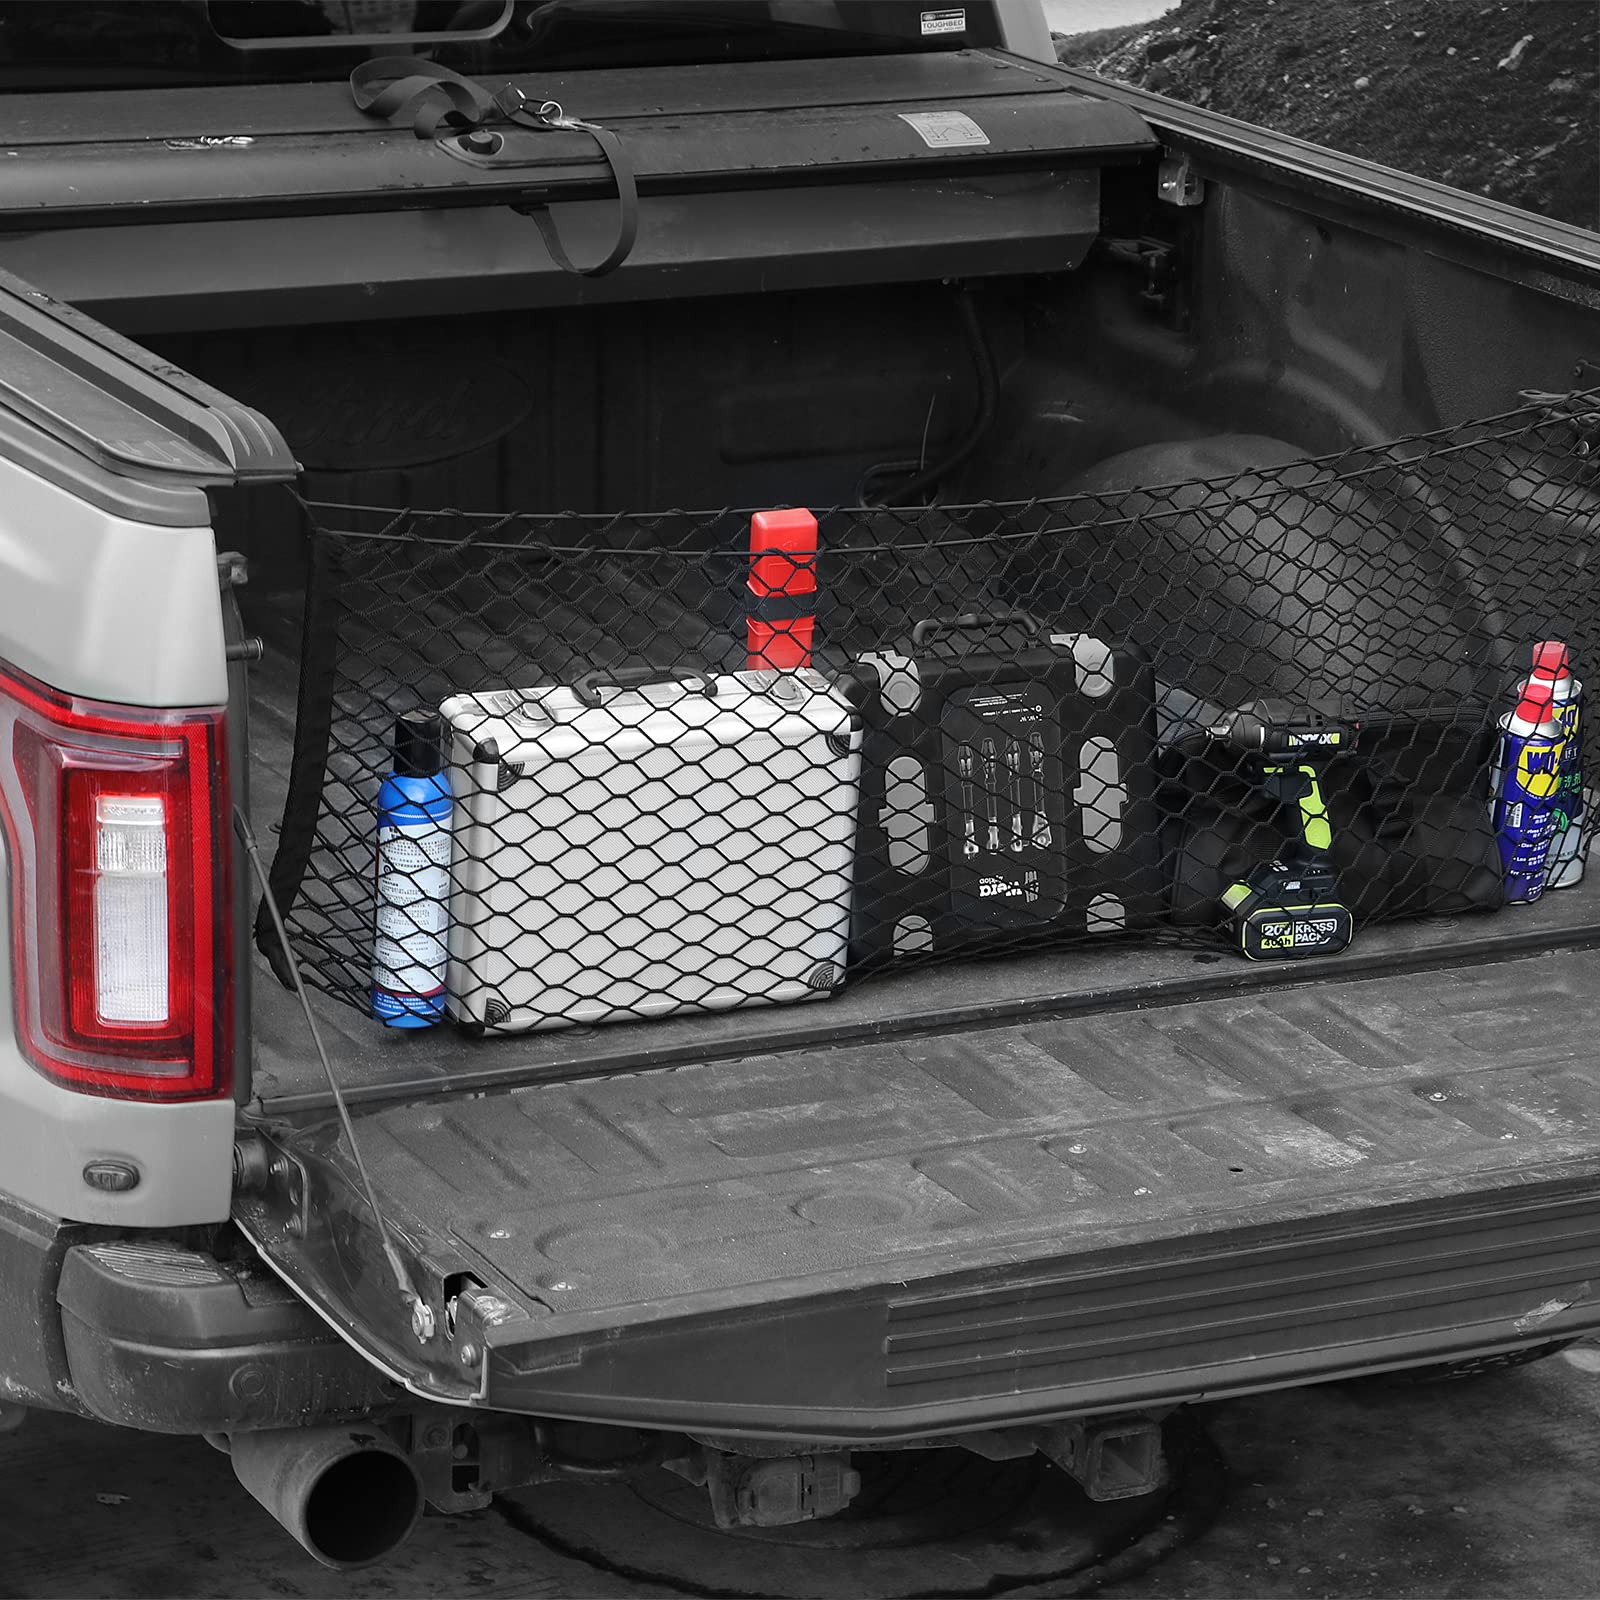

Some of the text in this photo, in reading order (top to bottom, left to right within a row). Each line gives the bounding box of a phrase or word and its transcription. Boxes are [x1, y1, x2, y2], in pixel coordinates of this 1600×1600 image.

[923, 20, 963, 29] TOUGHBED
[979, 881, 1023, 897] Wera
[1295, 922, 1334, 934] KROSS
